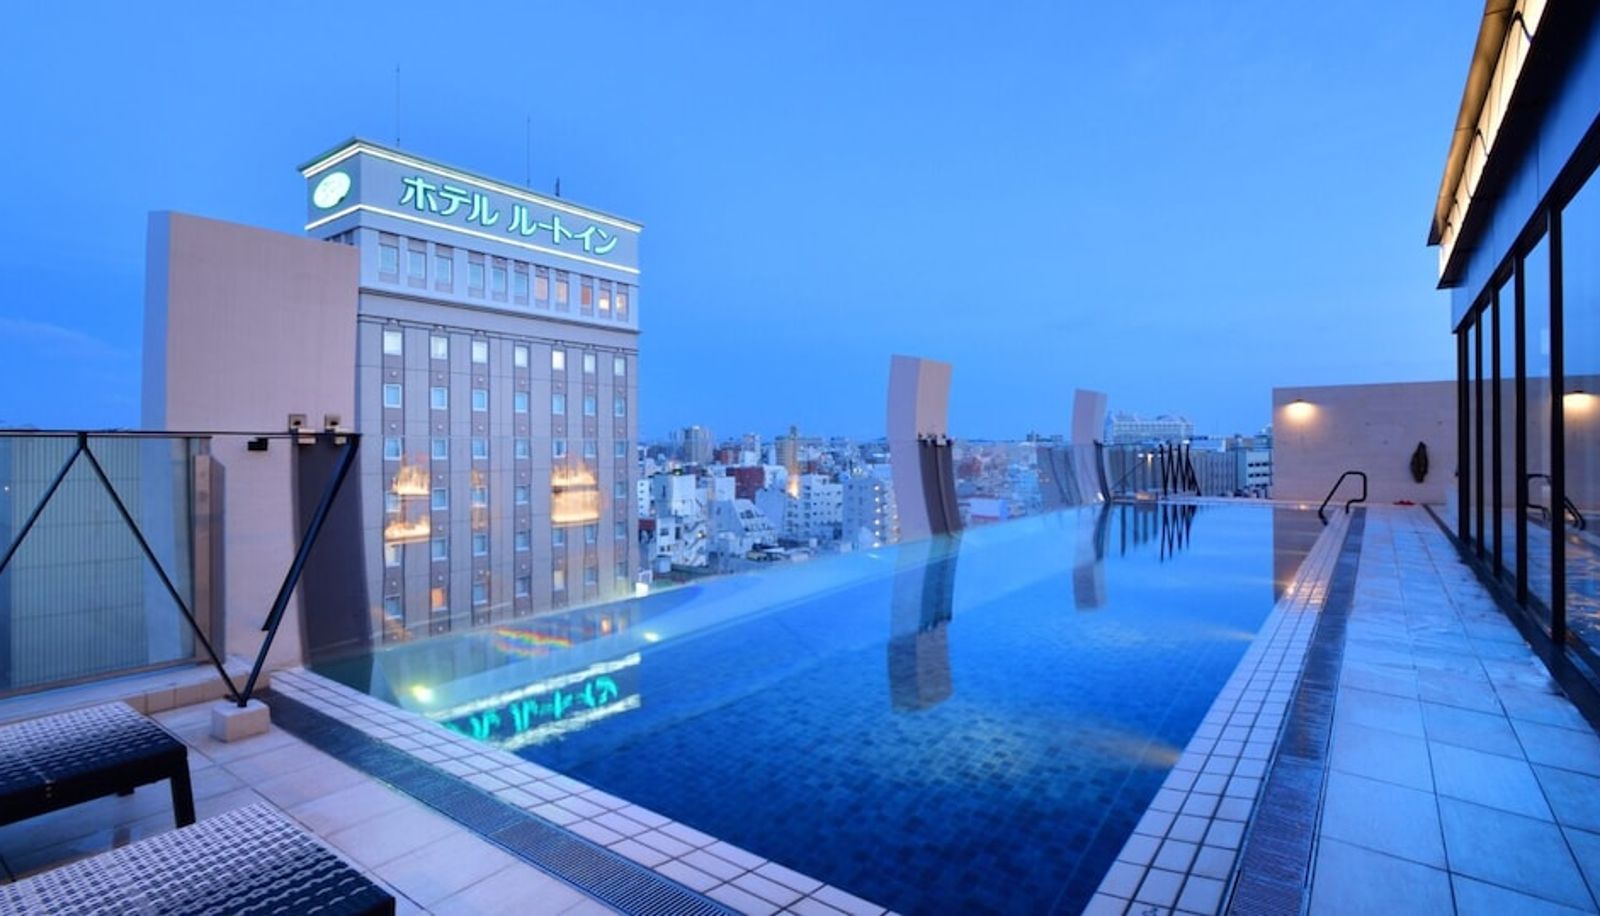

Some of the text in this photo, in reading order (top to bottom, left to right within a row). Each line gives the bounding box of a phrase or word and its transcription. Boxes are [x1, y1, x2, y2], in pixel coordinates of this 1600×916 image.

[400, 176, 618, 254] ホテル ルートイン
